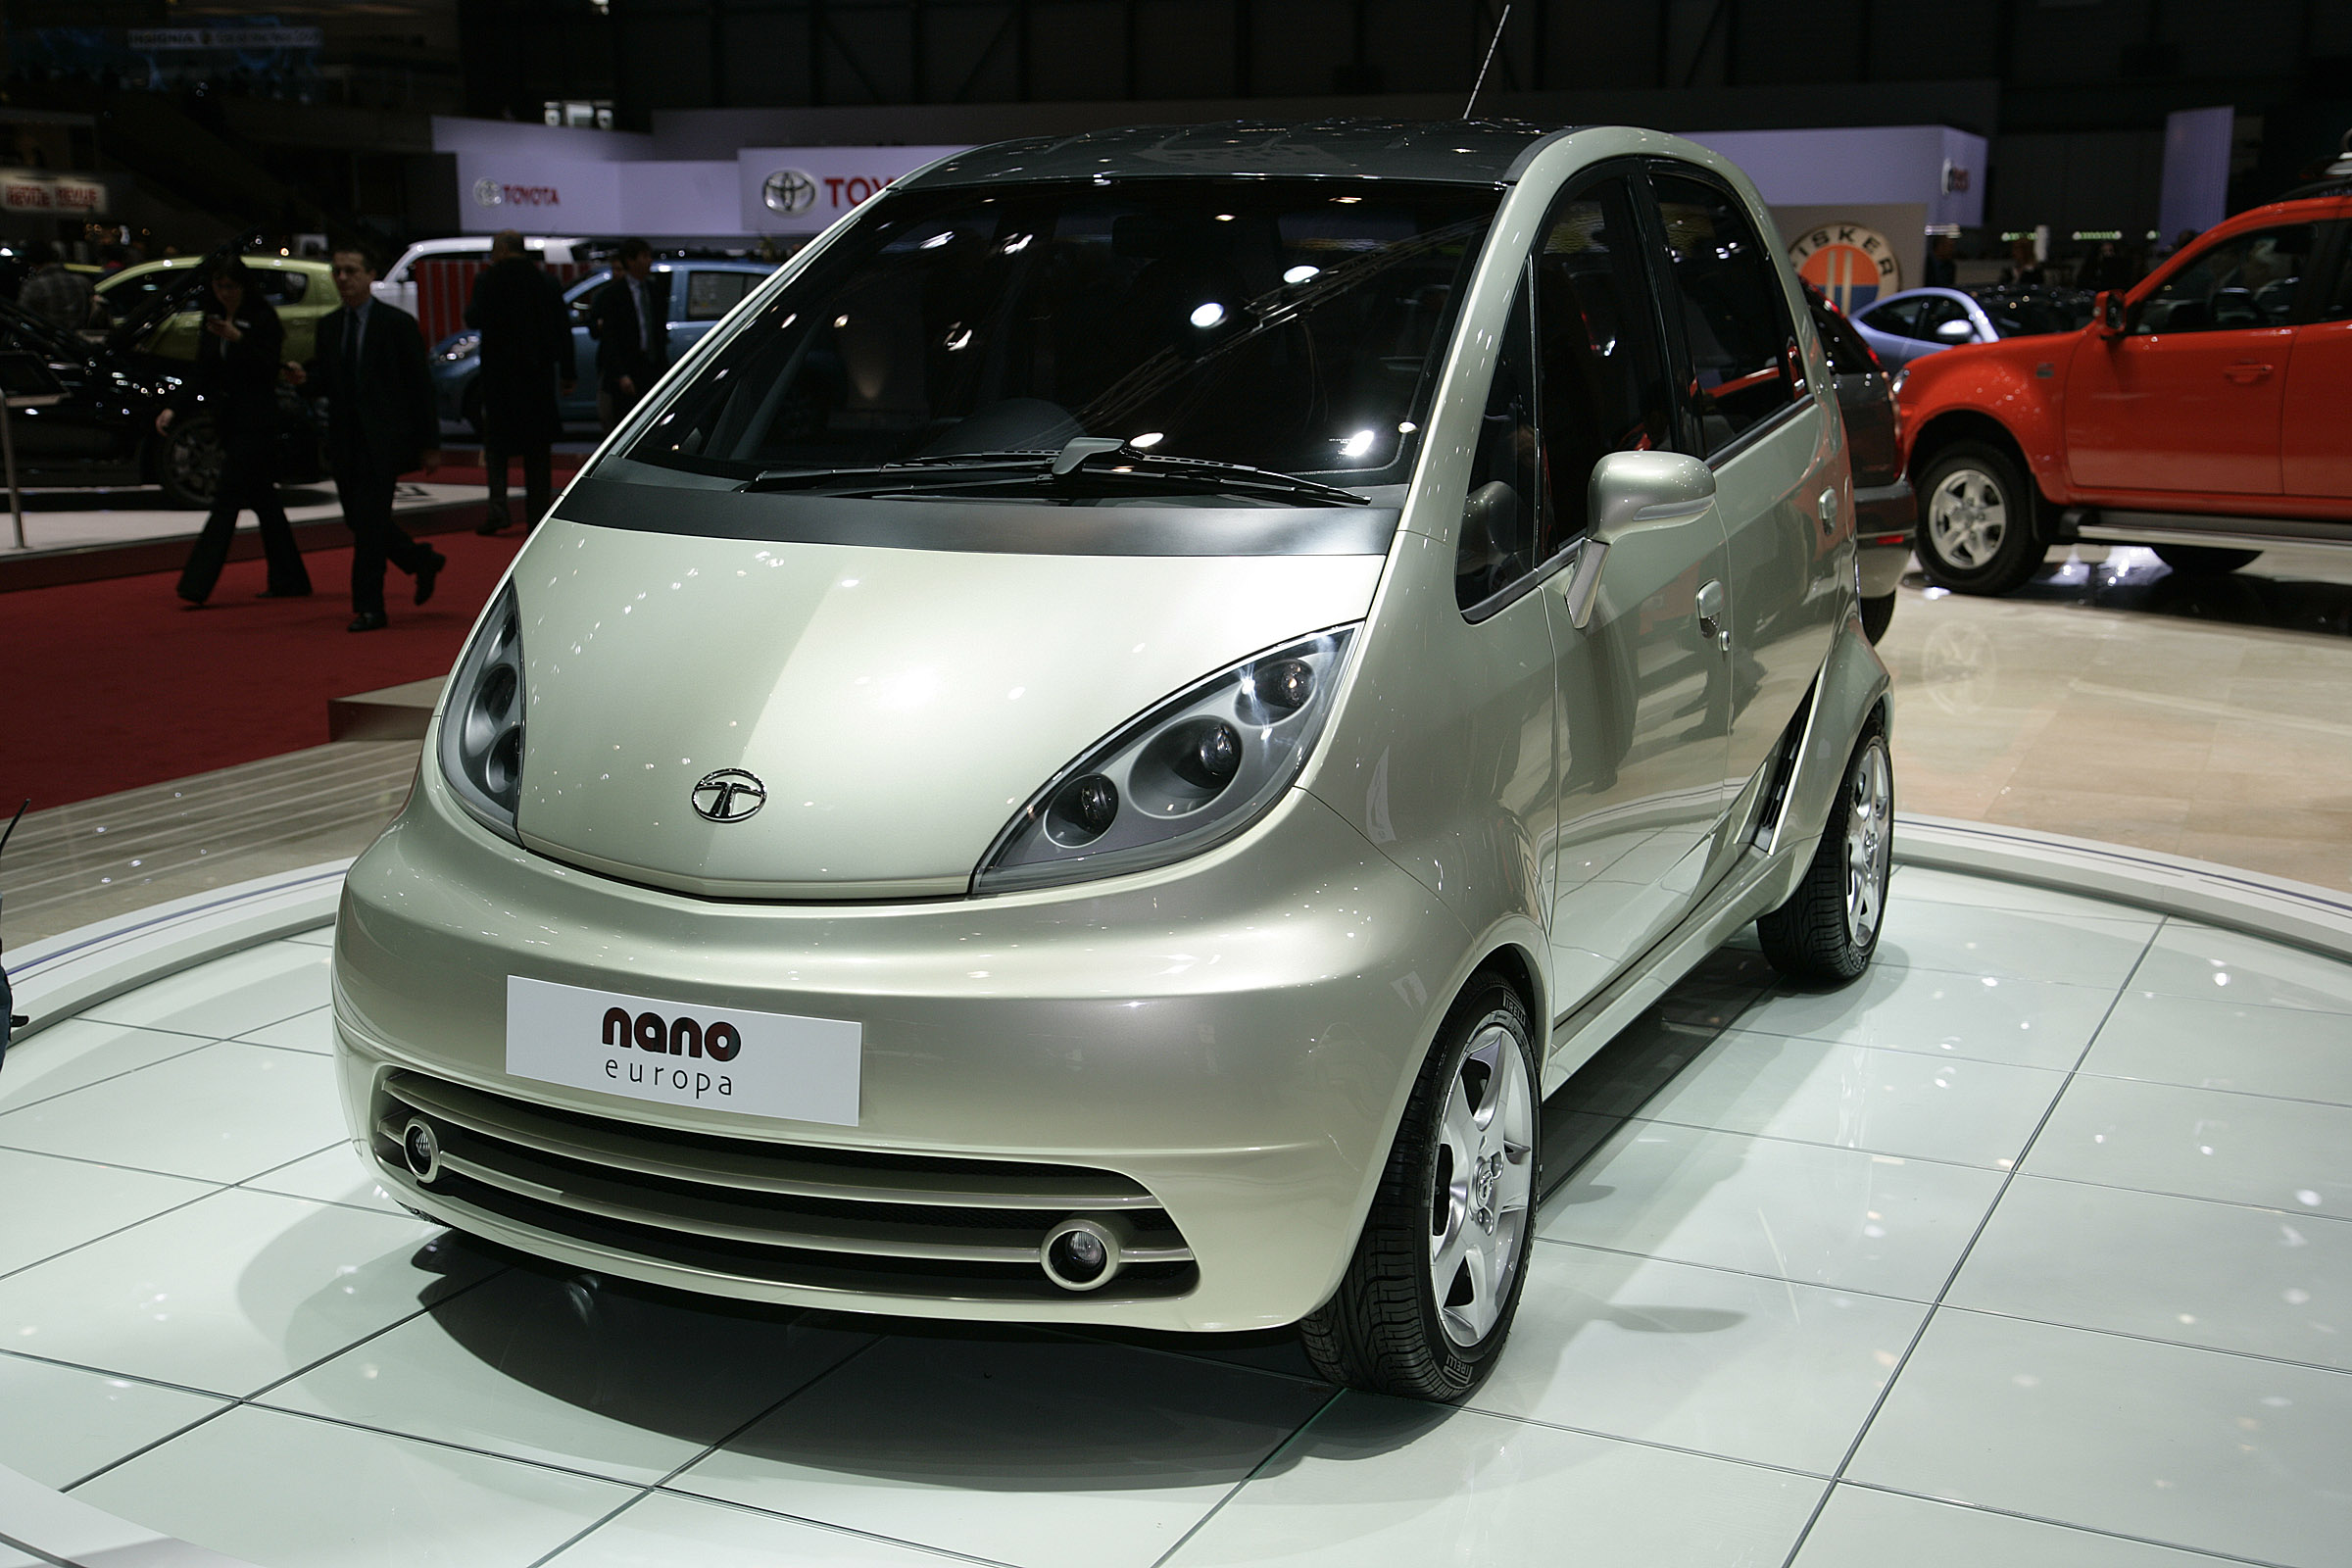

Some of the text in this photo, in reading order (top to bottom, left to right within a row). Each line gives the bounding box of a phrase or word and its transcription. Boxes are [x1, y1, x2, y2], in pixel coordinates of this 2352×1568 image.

[7, 193, 51, 208] REVUE
[503, 184, 560, 206] TOYOTA
[1791, 226, 1894, 275] ISKER
[1502, 987, 1527, 1028] PIRELLI
[602, 1006, 742, 1062] nano
[605, 1058, 732, 1100] europa
[1442, 1353, 1474, 1385] PIRELLI
